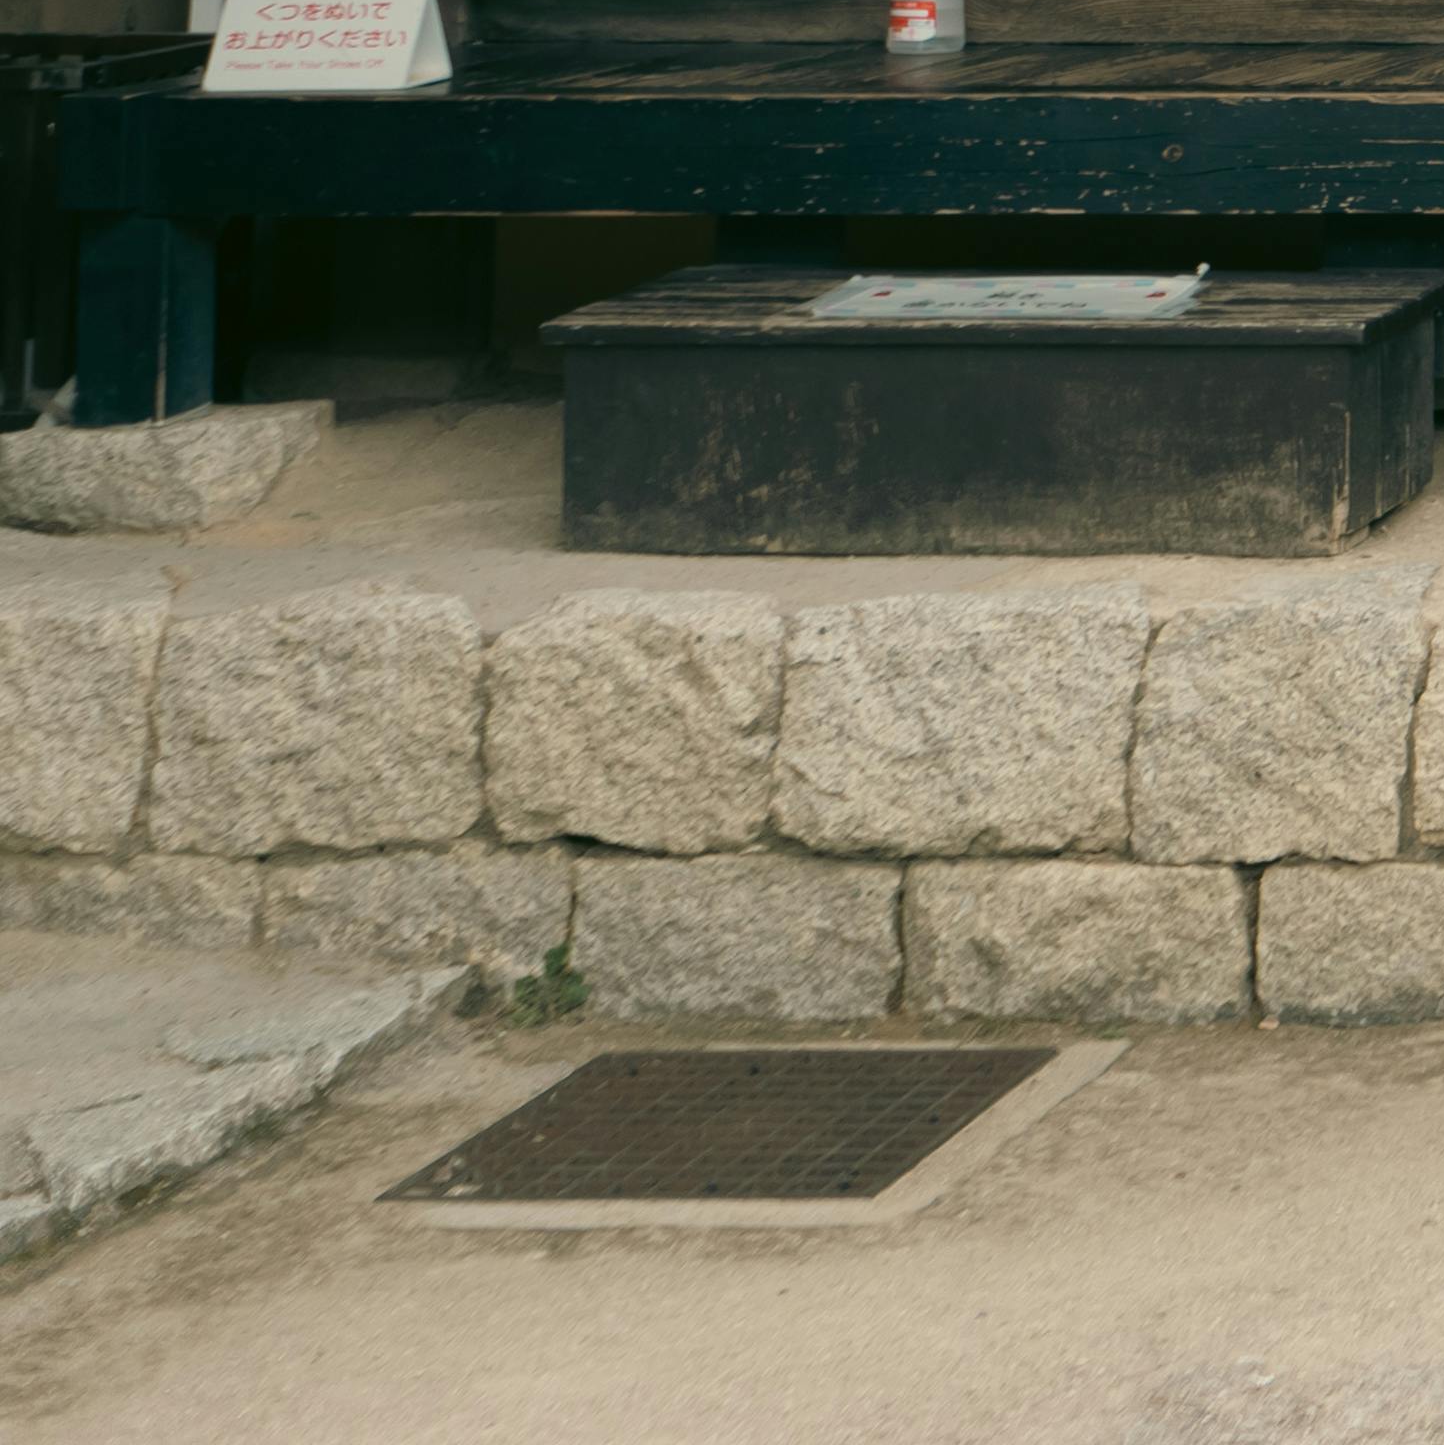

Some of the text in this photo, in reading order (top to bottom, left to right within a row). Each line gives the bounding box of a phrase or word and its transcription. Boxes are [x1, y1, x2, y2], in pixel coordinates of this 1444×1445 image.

[255, 1, 392, 21] くつをぬいて
[223, 29, 407, 51] お上がりください
